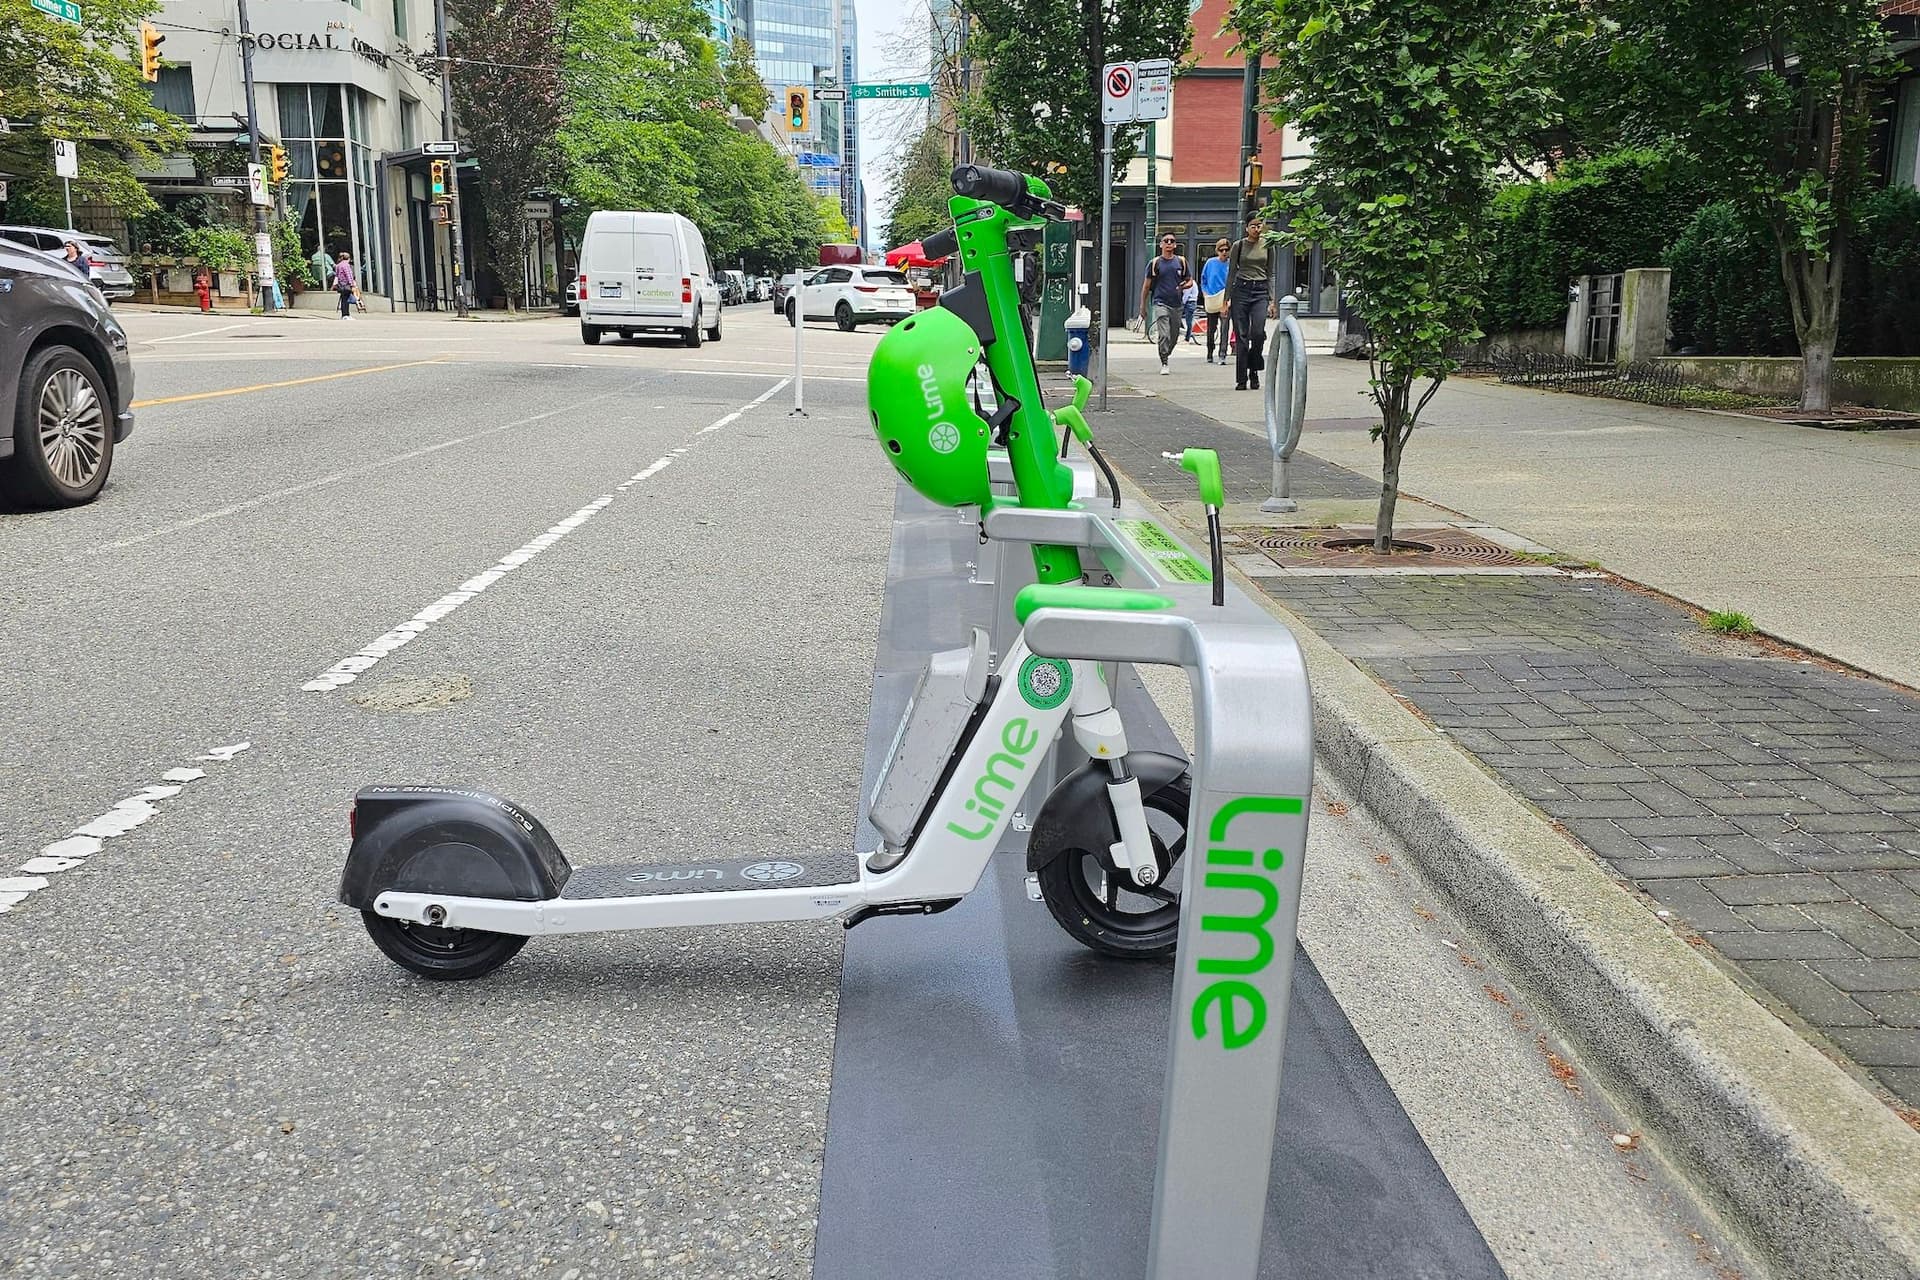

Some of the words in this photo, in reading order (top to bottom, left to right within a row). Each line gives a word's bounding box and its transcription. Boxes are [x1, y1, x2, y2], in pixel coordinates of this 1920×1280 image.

[65, 4, 77, 20] St
[875, 87, 908, 97] Smithe
[909, 87, 922, 96] St.
[641, 289, 674, 297] canteen
[917, 363, 945, 420] Lime
[946, 717, 1040, 841] Lime
[402, 786, 484, 800] Sidewalk
[488, 797, 534, 833] Riding
[626, 869, 724, 883] Lime
[1191, 795, 1303, 1051] Lime
